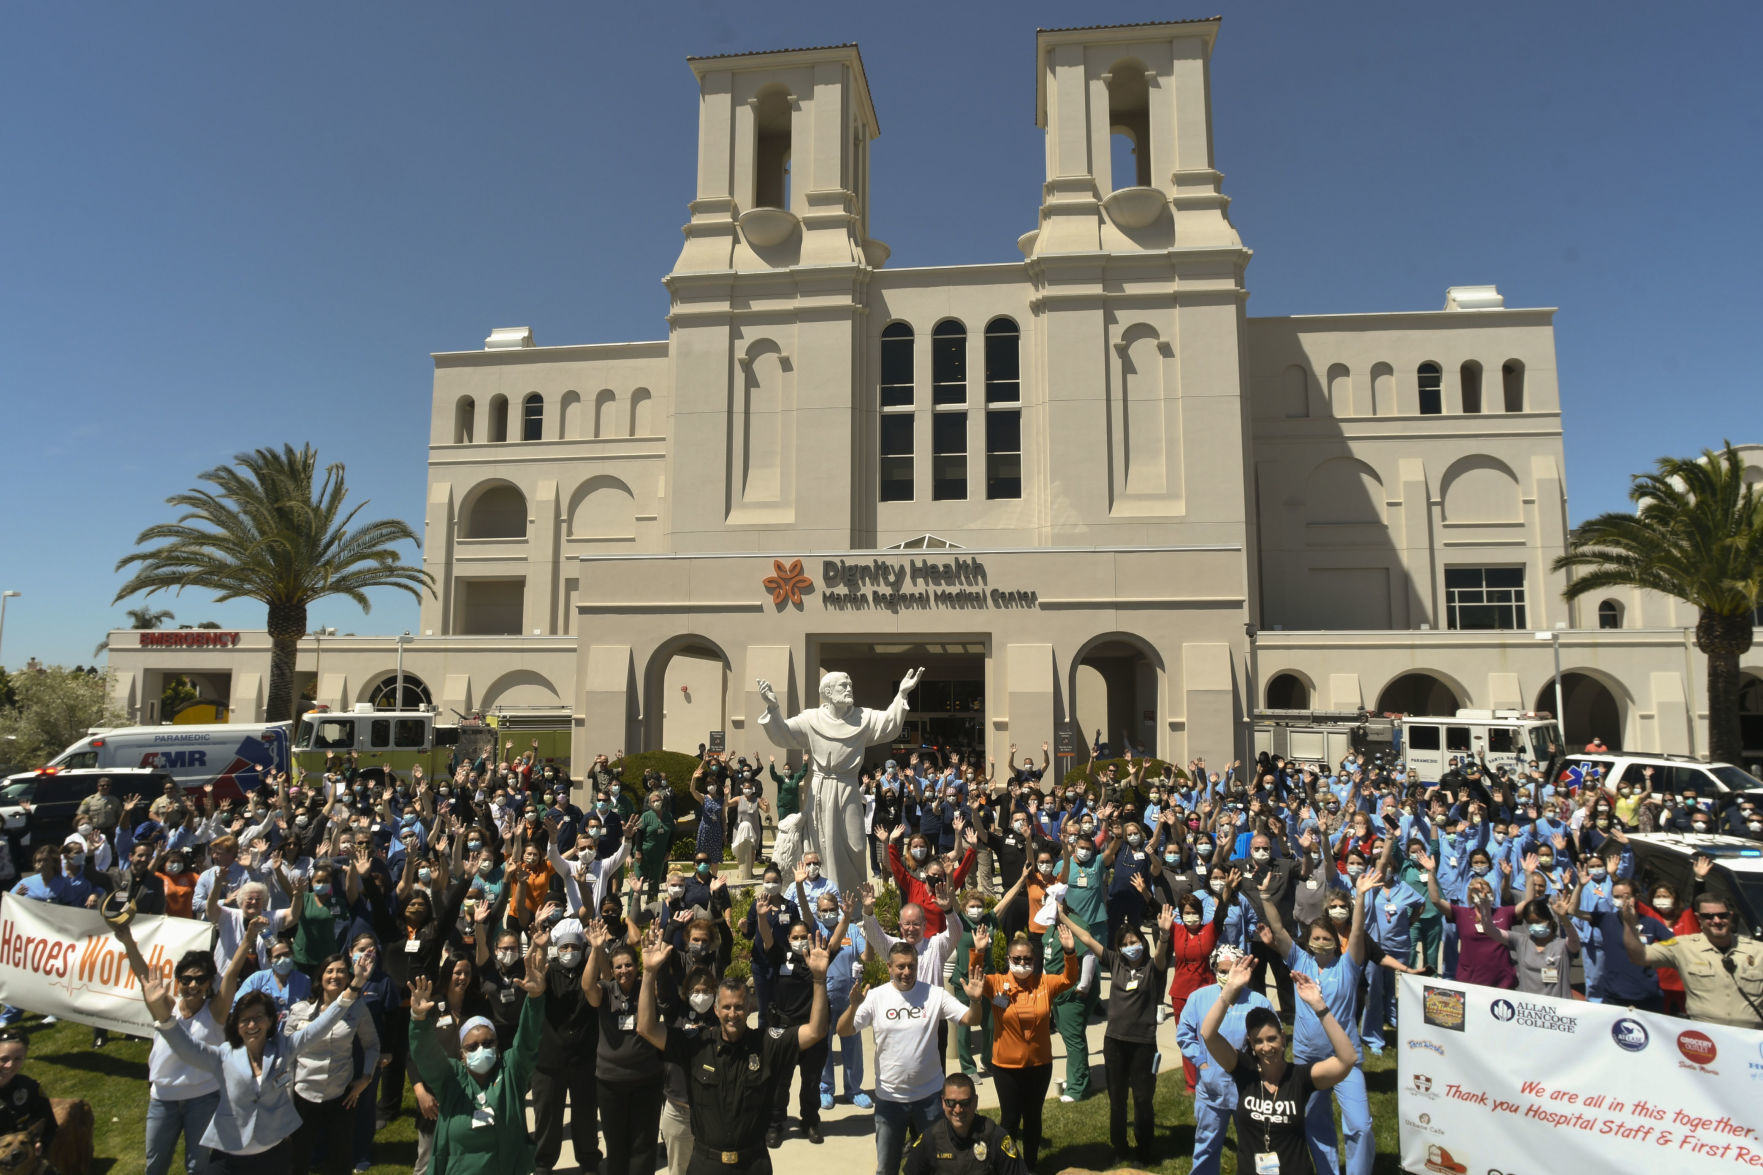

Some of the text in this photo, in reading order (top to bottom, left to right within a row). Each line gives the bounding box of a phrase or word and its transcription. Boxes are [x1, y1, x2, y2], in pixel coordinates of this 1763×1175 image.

[822, 557, 986, 588] Dignity Health
[823, 588, 1038, 611] Marian Regional Medical Center
[140, 632, 240, 647] EMERGENCY
[154, 733, 211, 742] PARAMEDIC
[138, 750, 207, 768] AMR
[0, 919, 77, 978] Heroes
[886, 1007, 921, 1020] one
[1517, 1001, 1557, 1014] ALLAN
[1516, 1017, 1575, 1033] COLLEGE
[1517, 1009, 1577, 1026] HANCOCK
[1680, 1036, 1712, 1048] GROCERY
[1244, 1095, 1297, 1115] CLUB 911
[1520, 1081, 1759, 1141] We are all in this together.
[1250, 1111, 1283, 1123] one
[1445, 1084, 1488, 1106] Thank
[1491, 1099, 1520, 1113] you
[1525, 1103, 1598, 1131] Hospital
[1600, 1119, 1654, 1142] Staff
[1656, 1130, 1674, 1146] &
[1679, 1135, 1732, 1160] First
